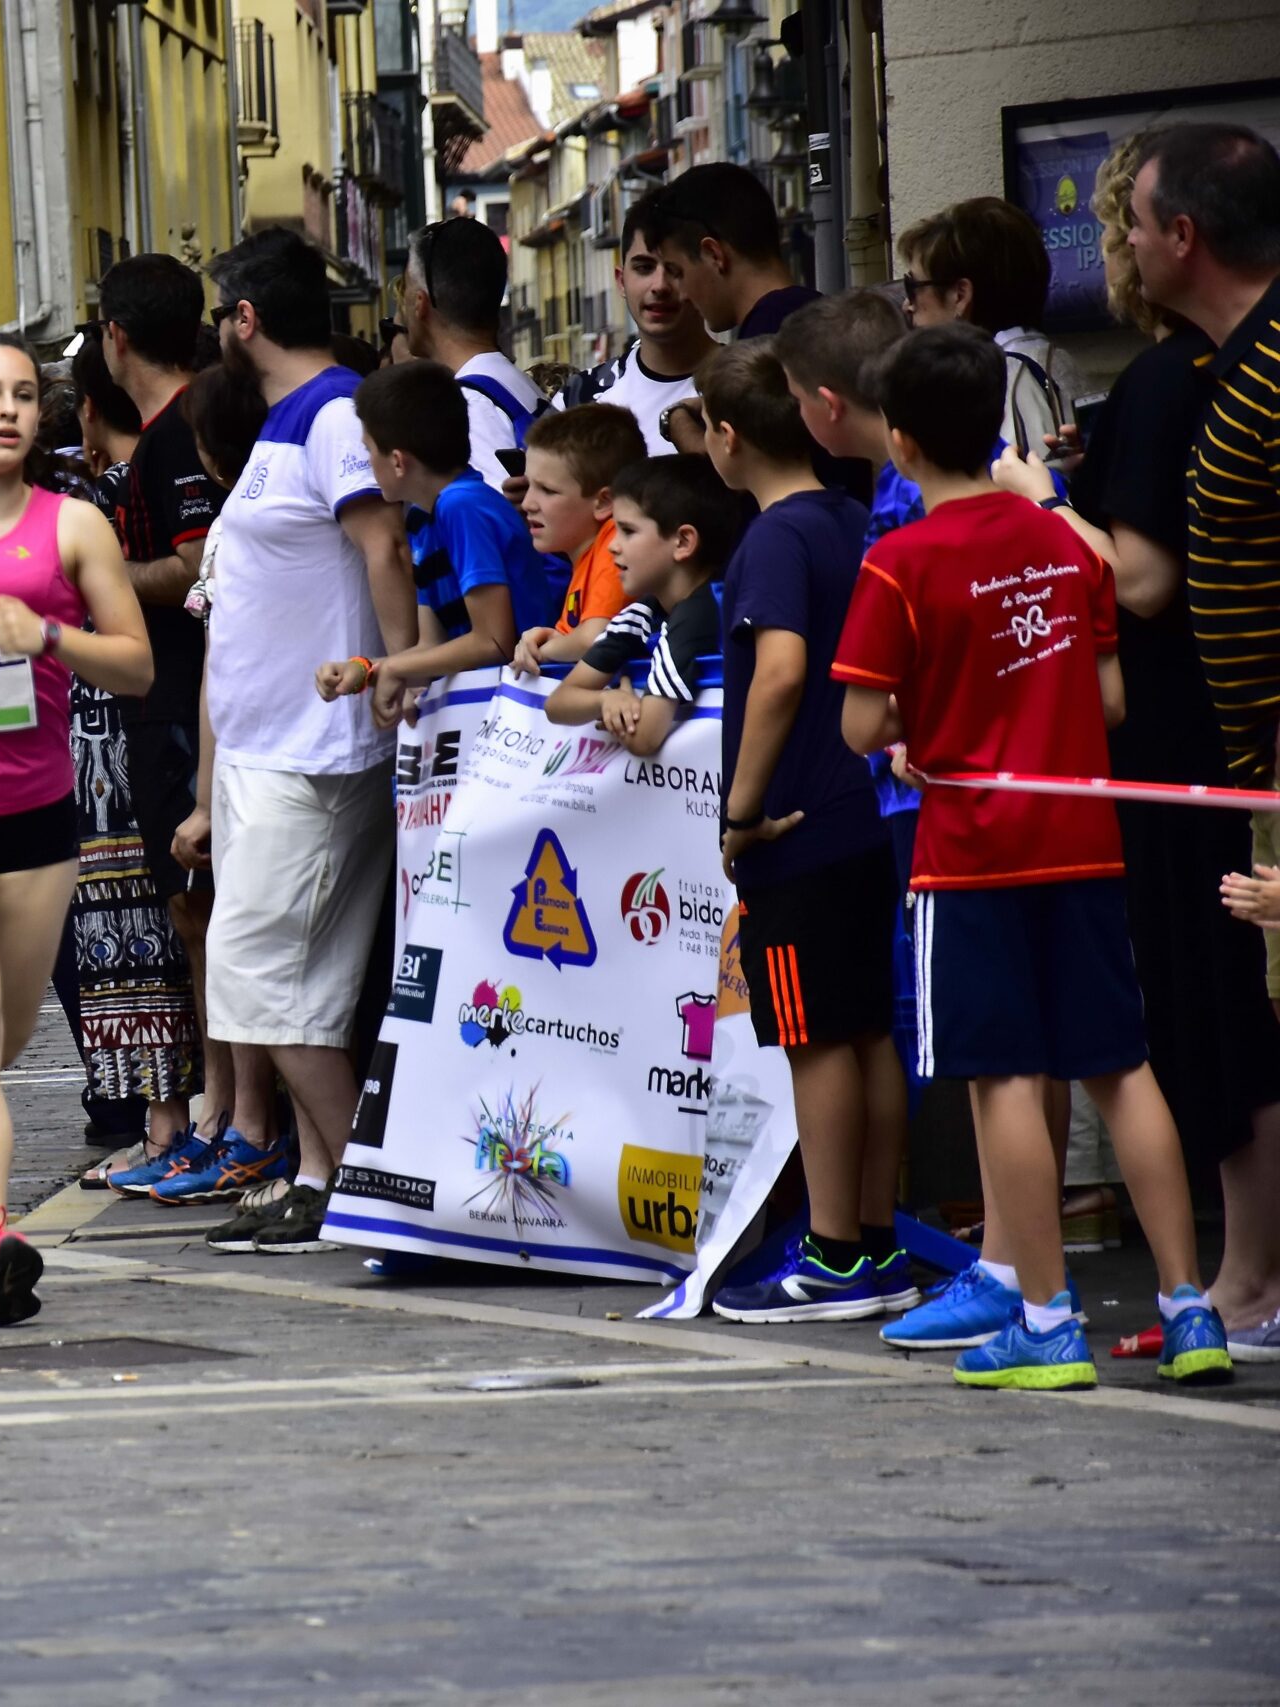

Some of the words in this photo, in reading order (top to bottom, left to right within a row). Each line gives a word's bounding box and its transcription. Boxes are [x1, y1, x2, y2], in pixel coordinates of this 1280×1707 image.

[970, 575, 1021, 599] Fundación
[685, 797, 720, 819] kutx
[678, 879, 720, 898] frutas
[679, 896, 724, 926] bida
[685, 943, 702, 955] 948
[704, 945, 719, 958] 185
[480, 1113, 574, 1141] PIROTECNIA
[343, 1168, 432, 1195] ESTUDIO
[469, 1209, 507, 1224] BERIAIN
